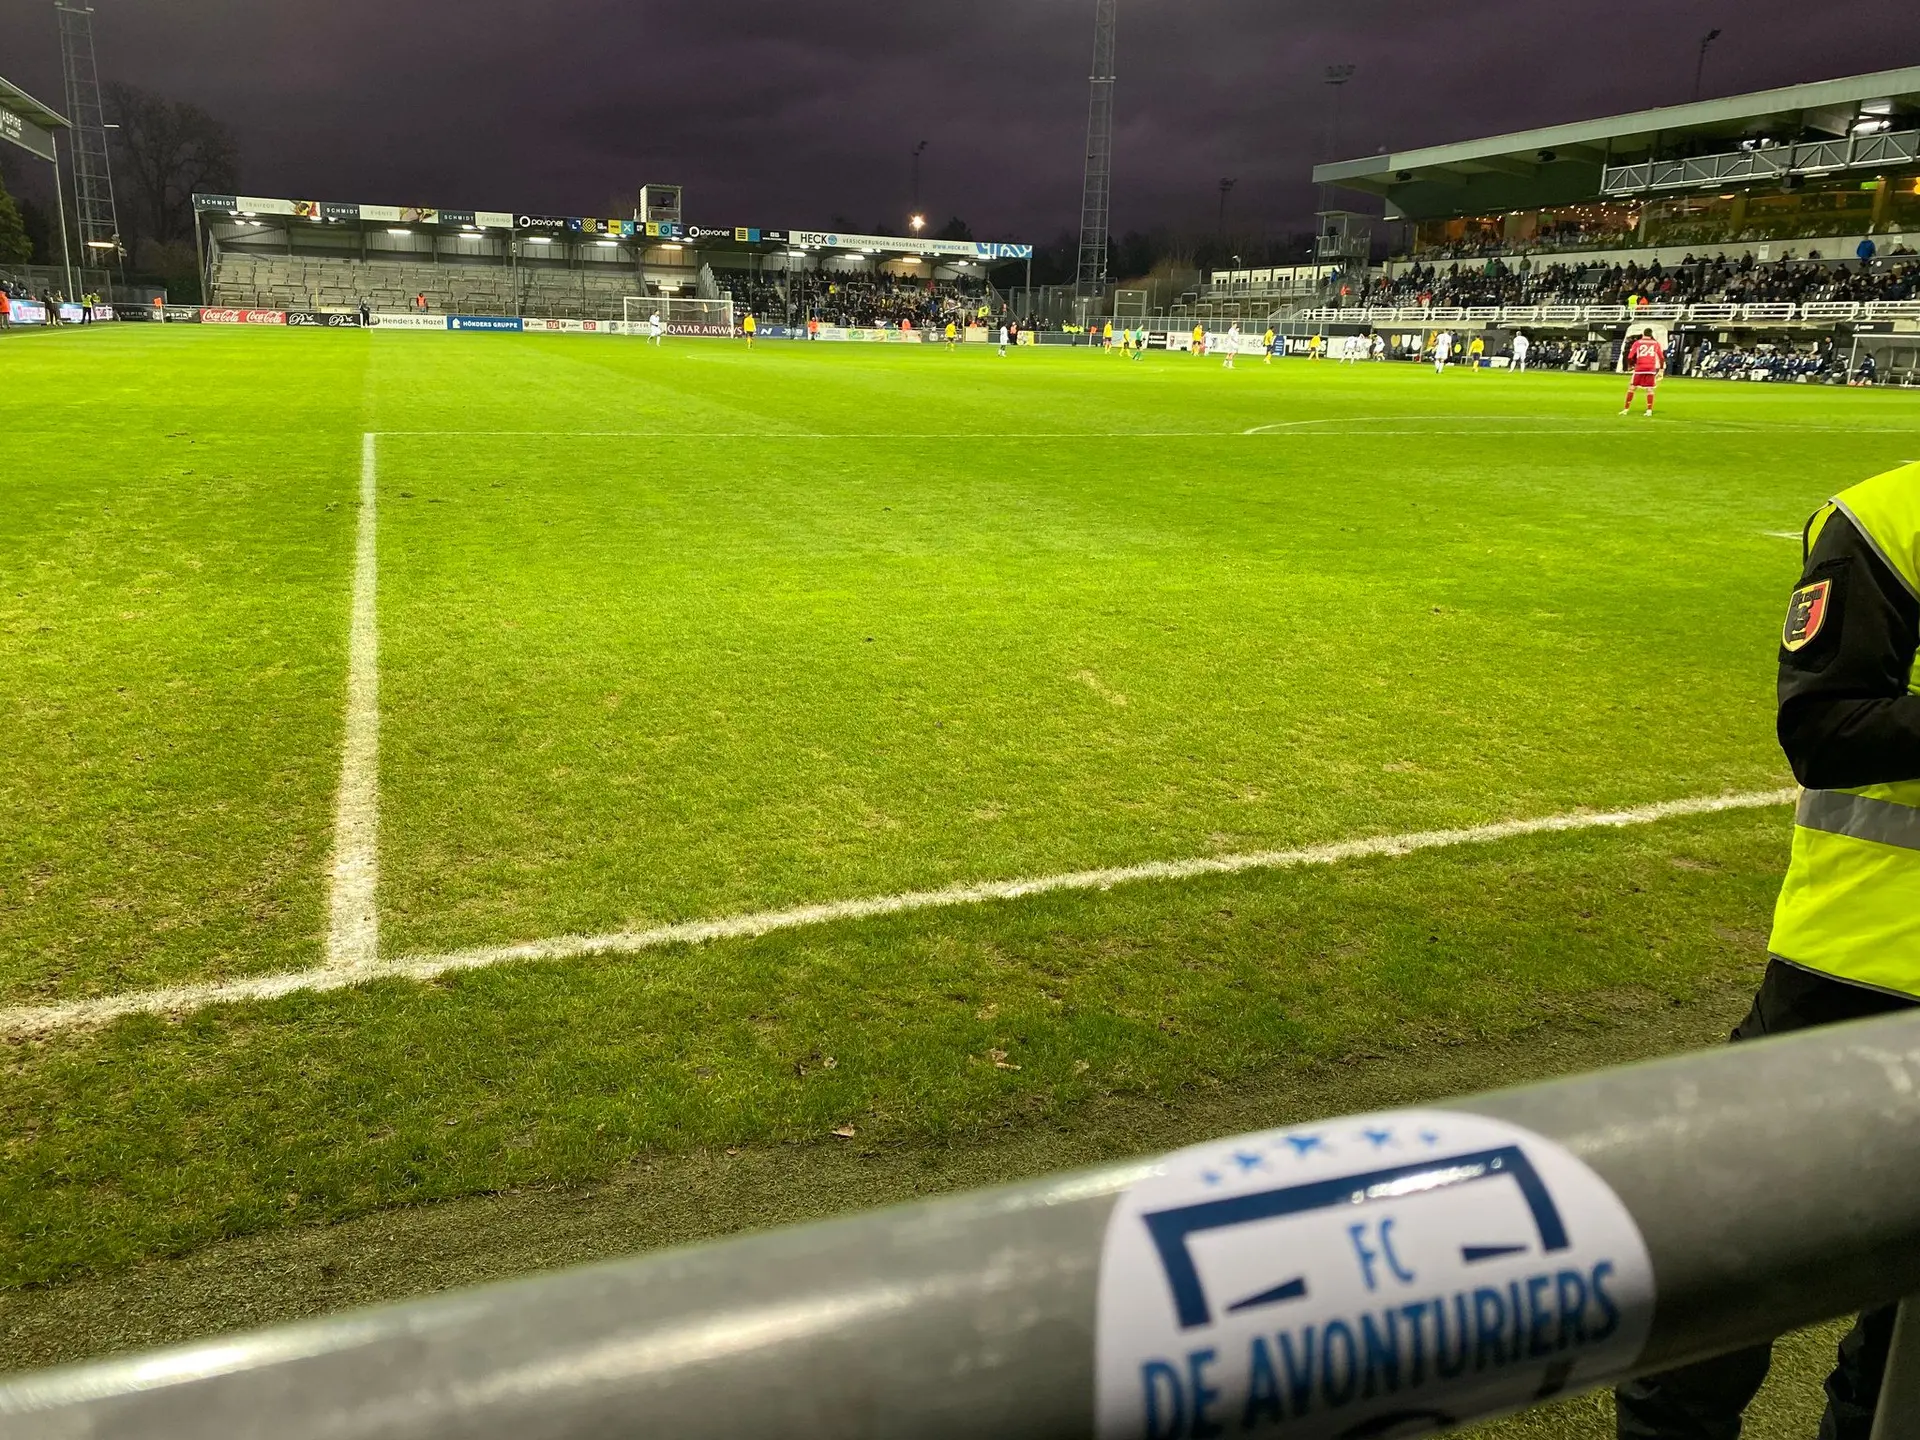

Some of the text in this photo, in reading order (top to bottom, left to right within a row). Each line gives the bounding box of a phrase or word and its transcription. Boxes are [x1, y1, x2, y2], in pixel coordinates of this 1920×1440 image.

[531, 219, 564, 227] pavonet
[700, 229, 730, 237] pavonet
[800, 233, 828, 244] HECK
[842, 238, 926, 249] VERSICHERUNGEN ASSURANCES
[462, 320, 518, 329] HÖNDERS GRUPPE
[667, 324, 742, 335] QATAR AIRWAYS
[1639, 344, 1655, 357] 24
[1348, 1218, 1415, 1290] FC
[1141, 1258, 1621, 1440] DE AVONTURIERS
